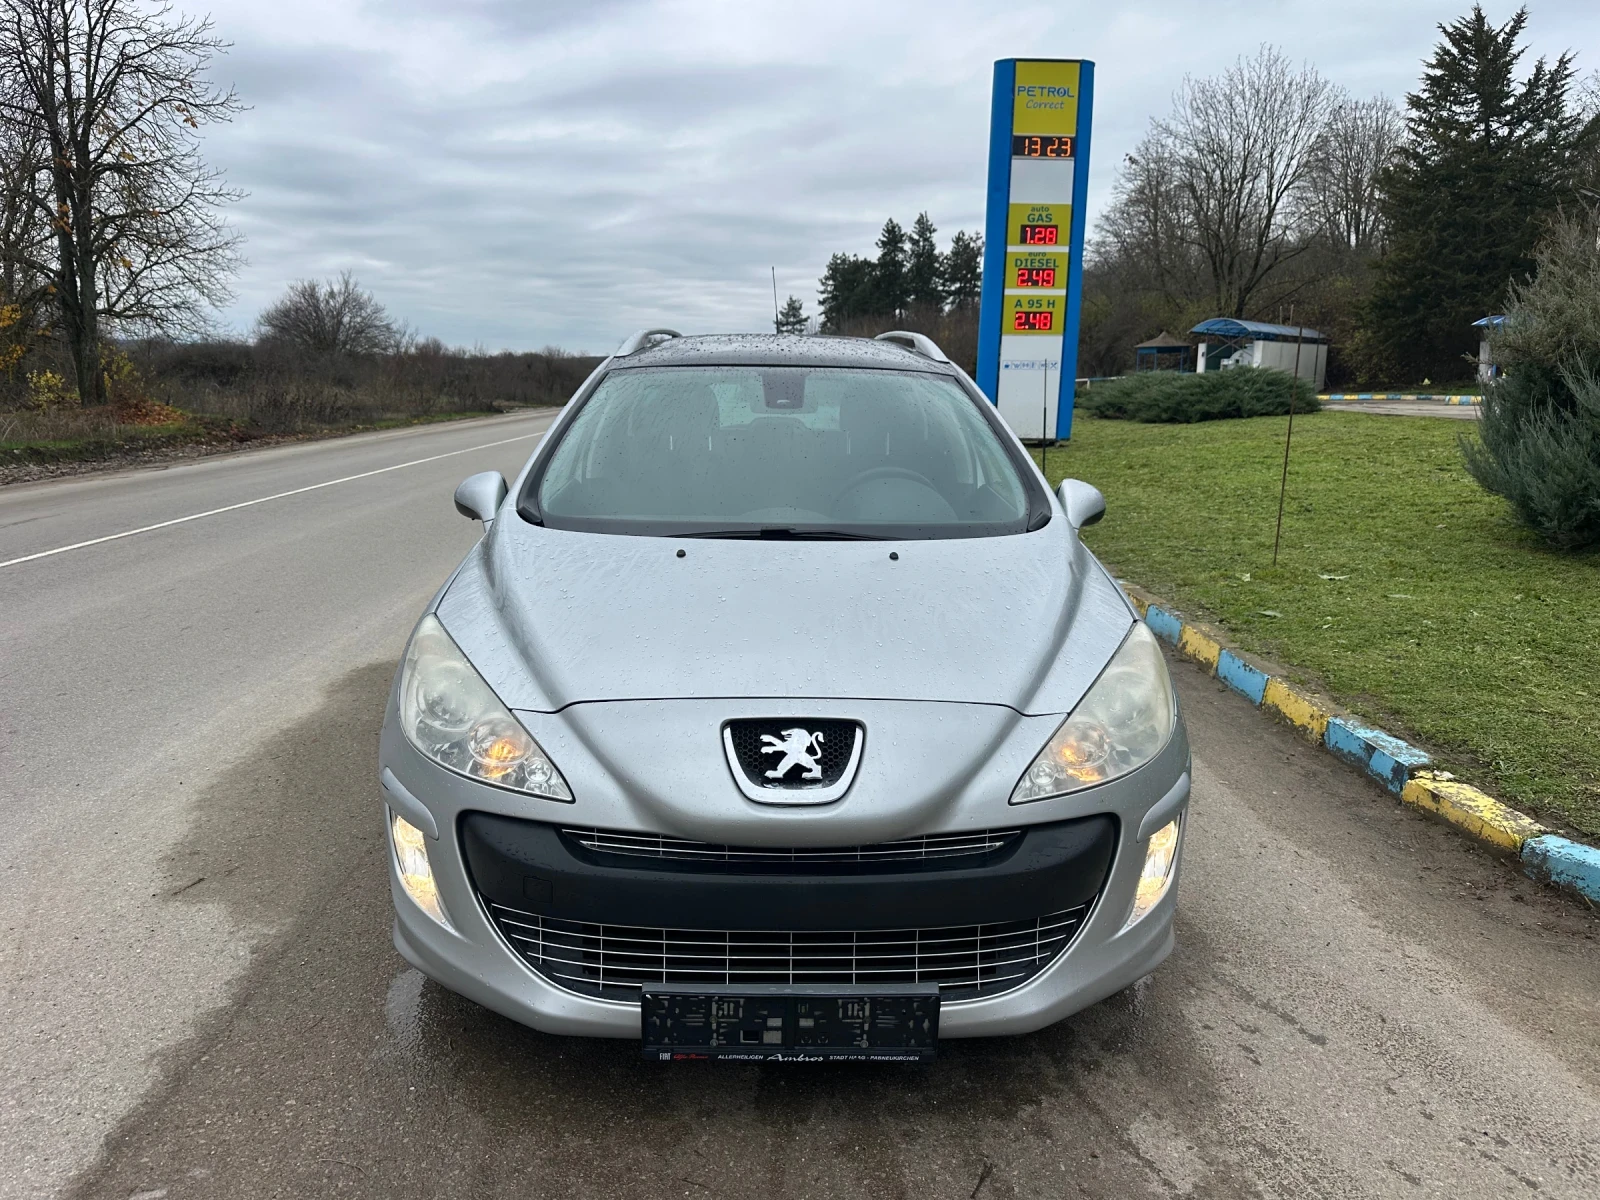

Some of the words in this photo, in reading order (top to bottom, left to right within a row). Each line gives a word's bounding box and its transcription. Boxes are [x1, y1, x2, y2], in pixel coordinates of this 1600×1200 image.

[1017, 86, 1075, 98] PETROL
[1025, 99, 1065, 109] Correct
[1027, 213, 1053, 223] GAS
[1025, 227, 1057, 244] 1.28
[1014, 258, 1059, 268] DIESEL
[1018, 269, 1055, 287] 2.49
[1014, 300, 1023, 309] A
[1027, 299, 1043, 309] 95
[1047, 299, 1056, 309] H
[1014, 312, 1052, 330] 2.48
[659, 1052, 672, 1061] FIAT
[766, 1053, 824, 1062] Ambros
